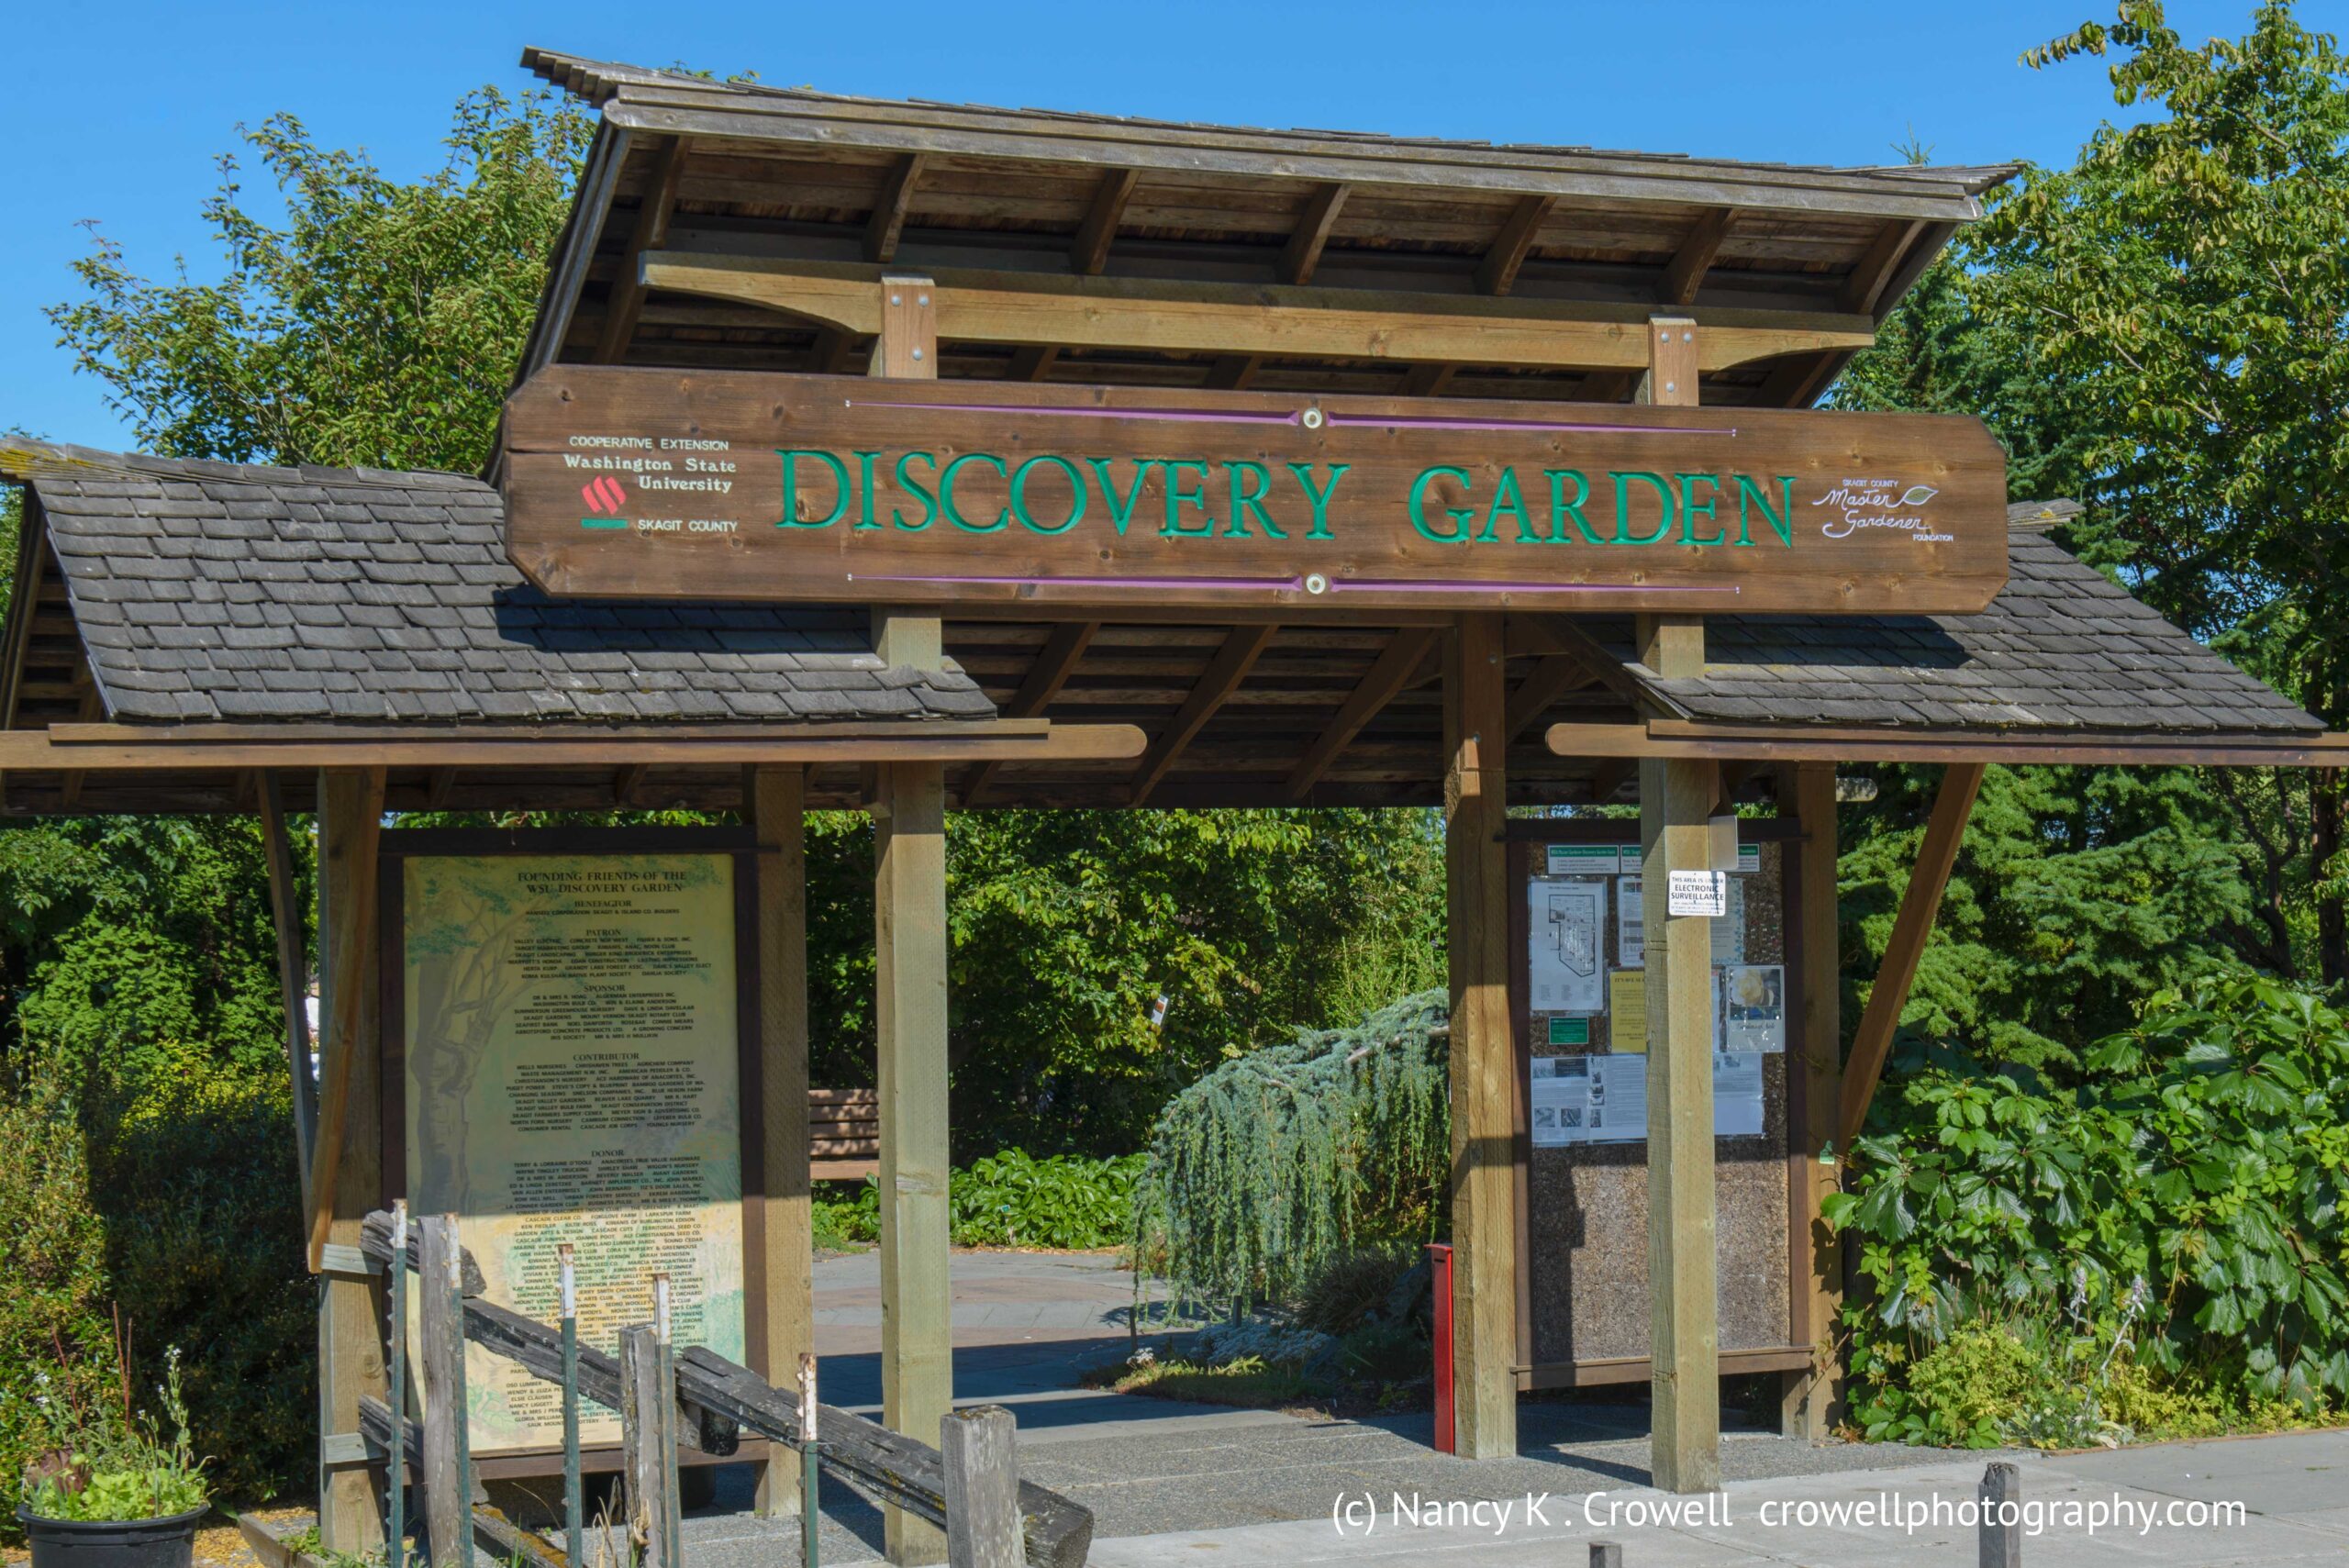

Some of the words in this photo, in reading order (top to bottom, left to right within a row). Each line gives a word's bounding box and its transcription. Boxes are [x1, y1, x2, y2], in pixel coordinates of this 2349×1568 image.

[569, 436, 652, 449] COOPERATIVE
[660, 438, 729, 451] EXTENSION
[563, 453, 673, 473] Washington
[685, 457, 737, 473] State
[637, 475, 732, 494] University
[774, 449, 1351, 539] DISCOVERY
[1408, 464, 1797, 549] GARDEN
[1812, 488, 1904, 511] Master
[637, 519, 683, 532] SKAGIT
[688, 520, 738, 533] COUNTY
[1822, 509, 1933, 539] Gardener
[1913, 534, 1954, 542] FOUNDATION
[518, 872, 582, 881] FOUNDING
[588, 872, 639, 881] FRIENDS
[643, 871, 656, 881] OF
[662, 871, 686, 880] THE
[528, 884, 552, 893] WSU
[559, 884, 626, 893] DISCOVERY
[632, 883, 682, 892] GARDEN
[1675, 884, 1719, 893] ELECTRONIC
[1671, 892, 1724, 901] SURVEILLANCE
